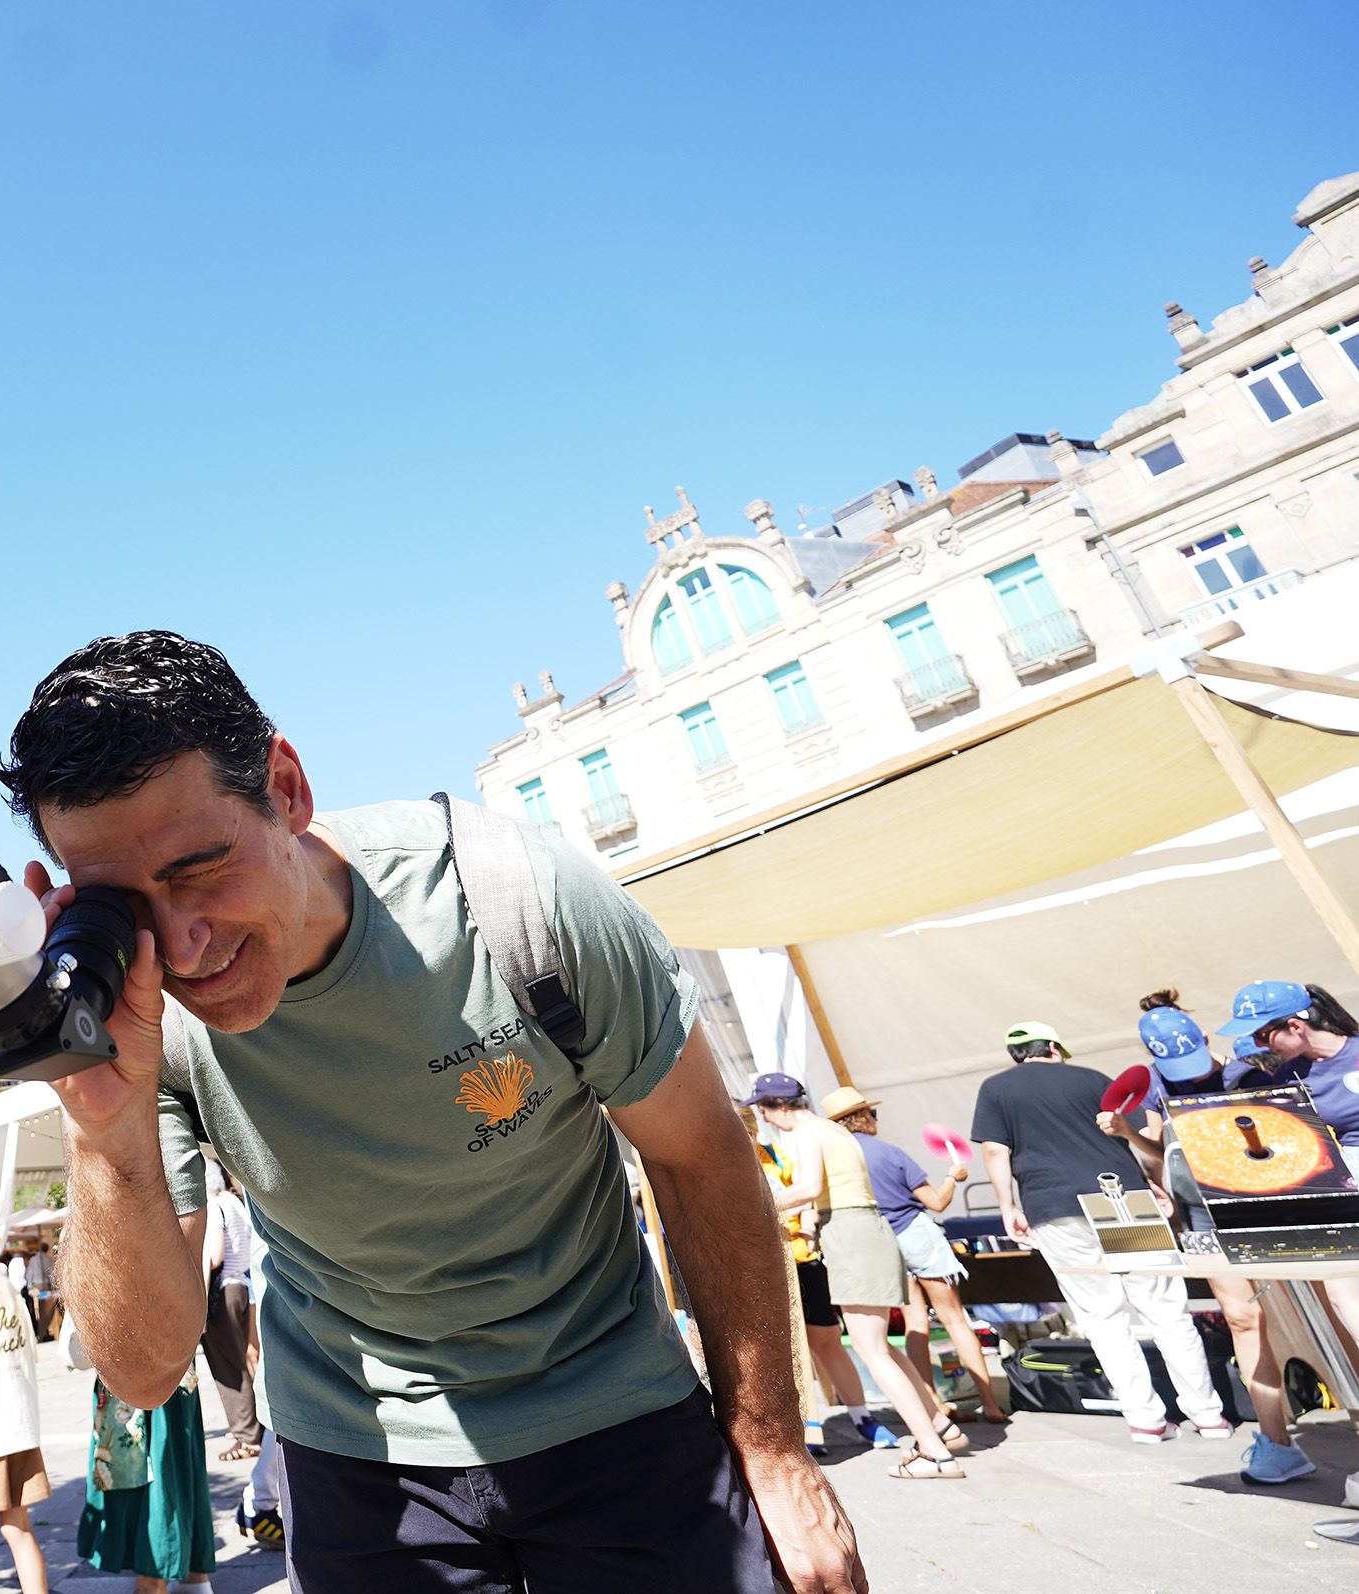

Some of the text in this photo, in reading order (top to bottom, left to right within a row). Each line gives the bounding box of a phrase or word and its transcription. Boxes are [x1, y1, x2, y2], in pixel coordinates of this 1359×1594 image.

[427, 1036, 487, 1074] SALTY
[466, 1085, 553, 1153] OF WAVES
